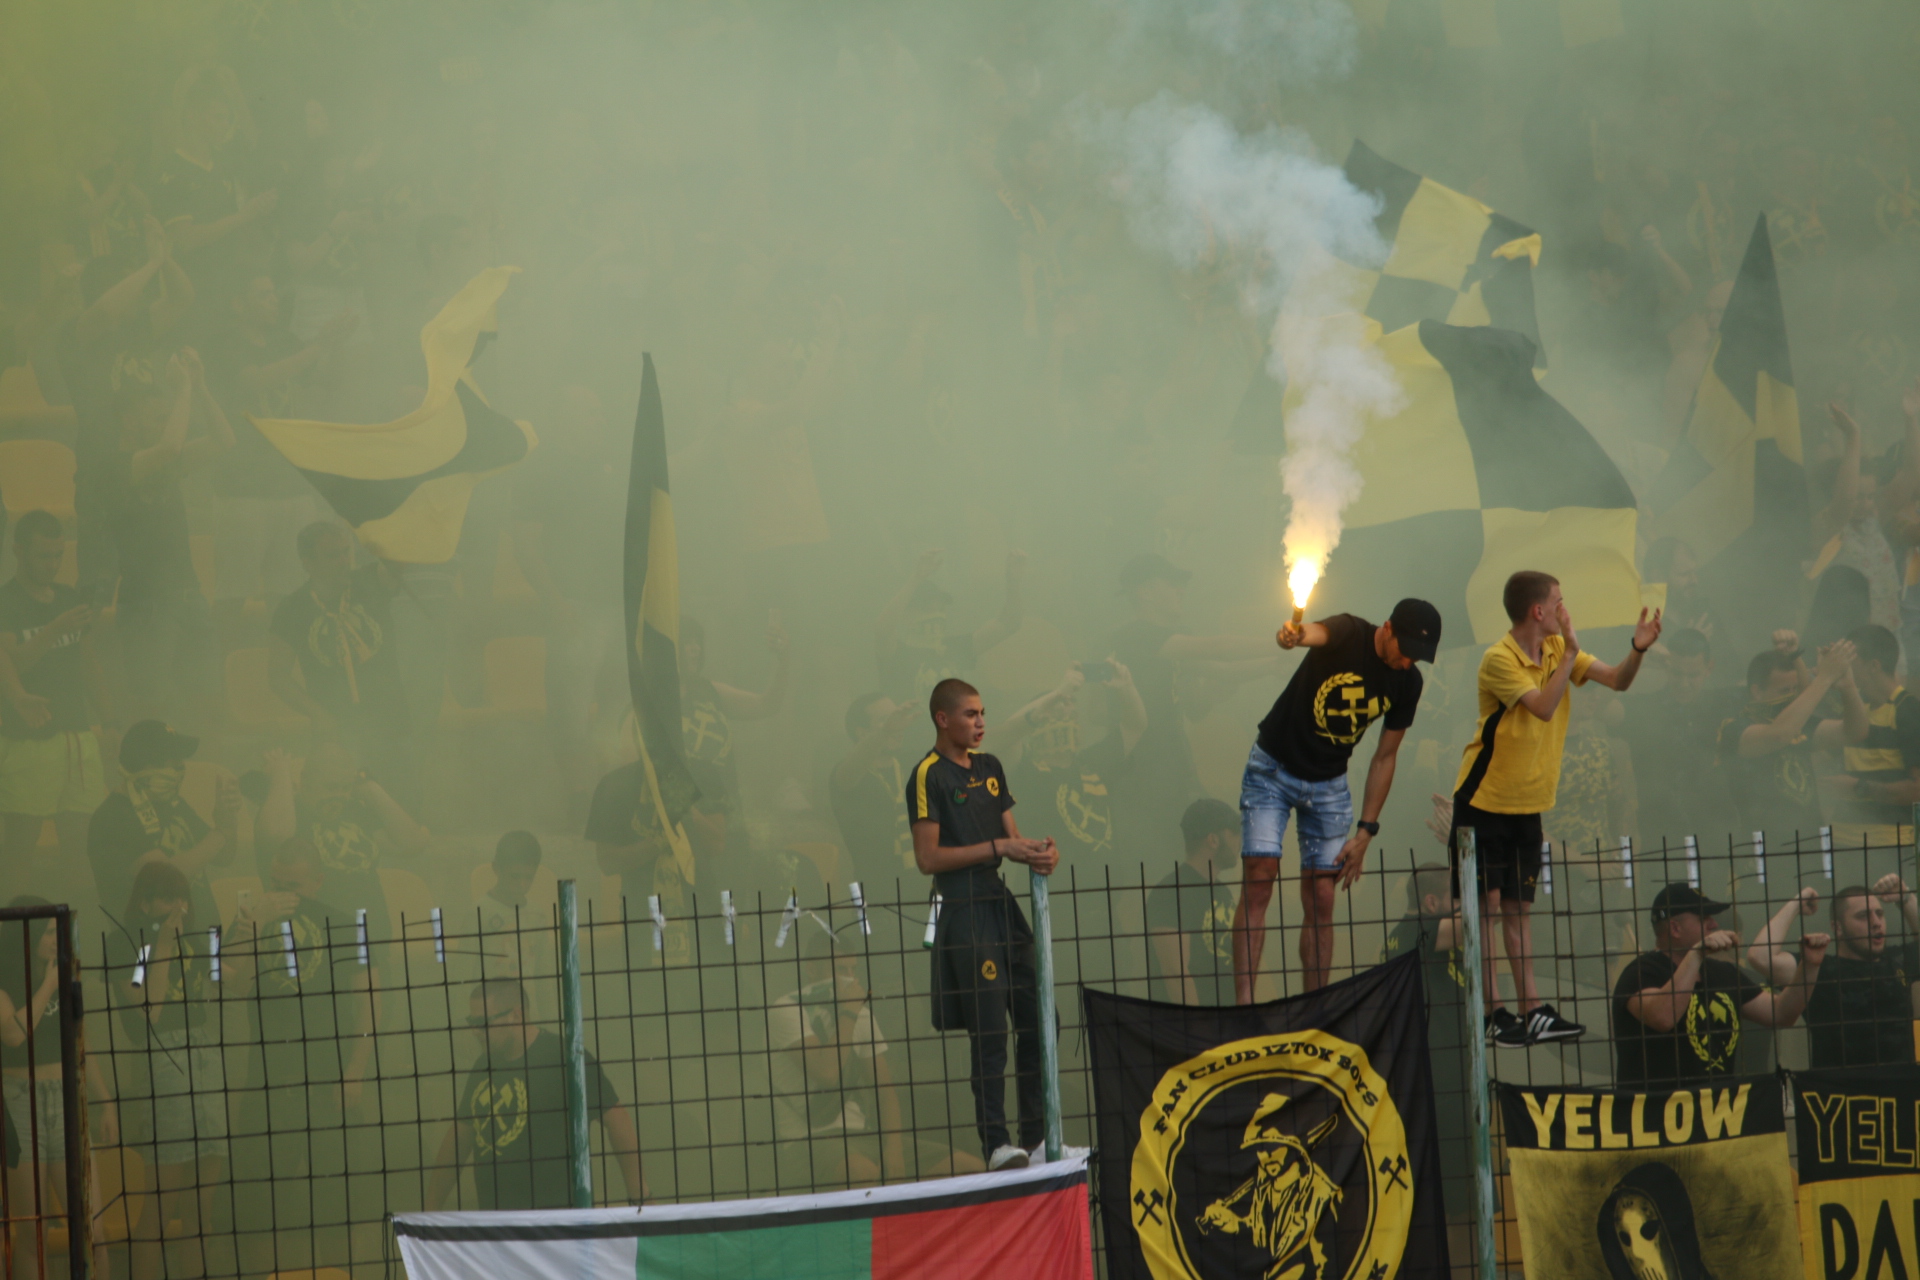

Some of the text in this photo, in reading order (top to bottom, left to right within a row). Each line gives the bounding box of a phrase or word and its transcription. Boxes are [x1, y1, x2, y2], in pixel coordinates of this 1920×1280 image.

[1153, 1041, 1380, 1136] FAN CLUB IZTOK BOYS
[1521, 1083, 1752, 1149] YELLOW
[1802, 1091, 1920, 1169] YEL
[1819, 1199, 1920, 1280] DA
